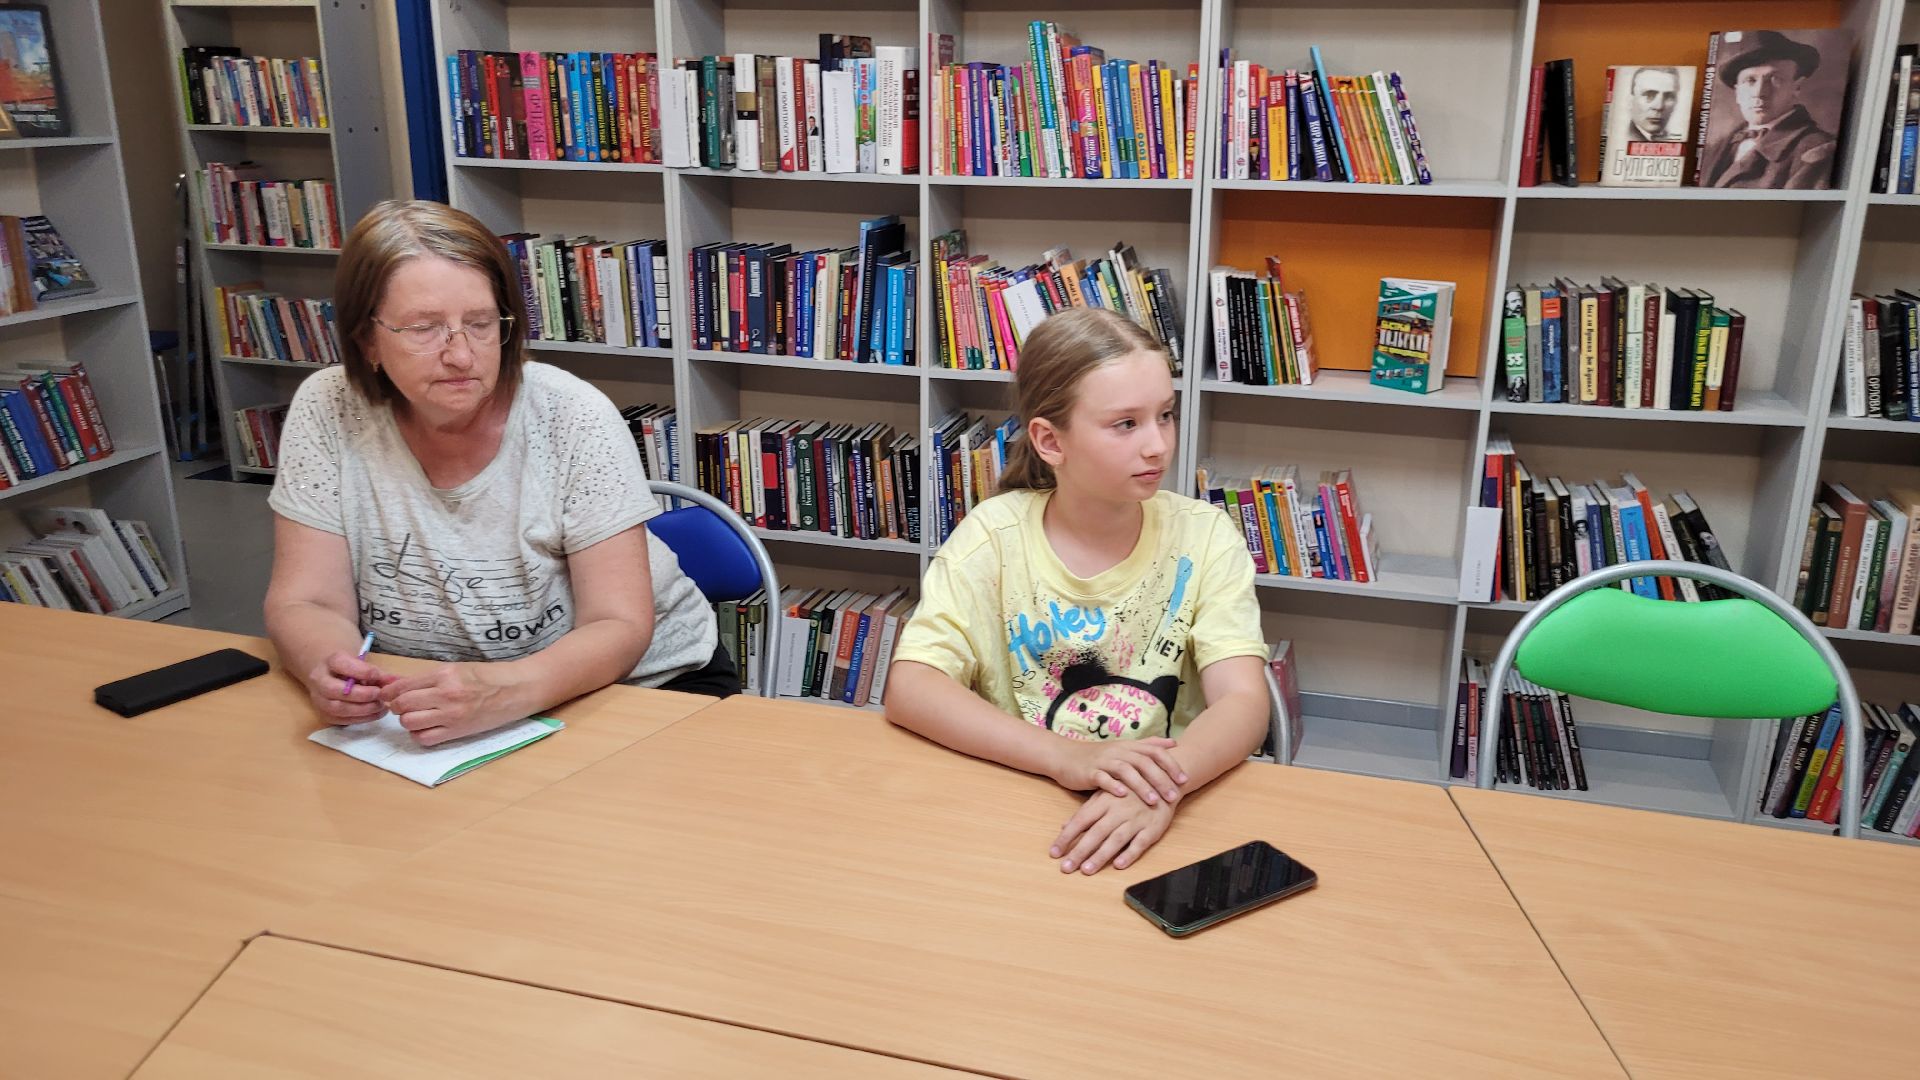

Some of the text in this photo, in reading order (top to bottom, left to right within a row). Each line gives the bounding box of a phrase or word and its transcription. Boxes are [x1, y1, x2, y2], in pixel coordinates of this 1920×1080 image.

[1309, 131, 1332, 177] КОРАЛИНА
[1868, 377, 1881, 412] ОРЛОВА
[1897, 543, 1919, 611] Православие
[486, 604, 565, 642] down
